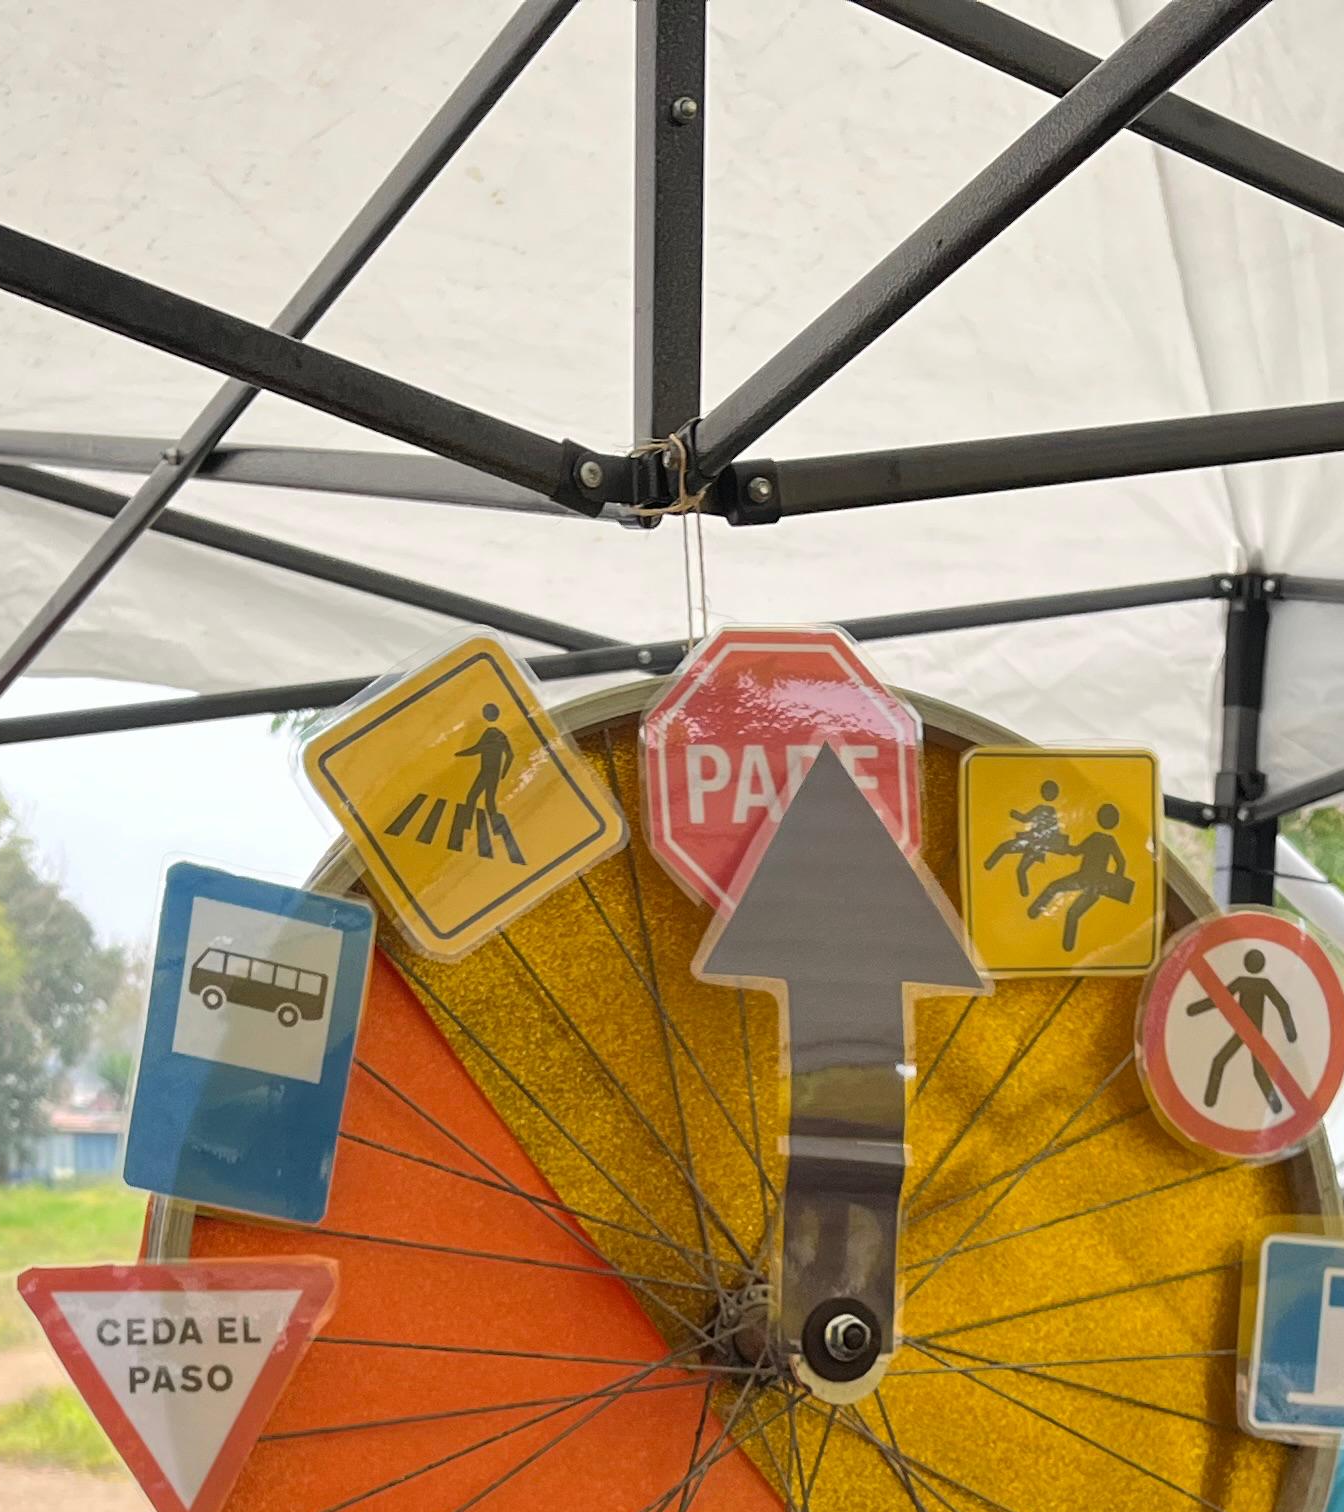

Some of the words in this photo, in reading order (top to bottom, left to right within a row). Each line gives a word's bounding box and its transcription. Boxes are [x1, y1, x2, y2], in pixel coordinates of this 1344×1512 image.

[96, 1317, 203, 1347] CEDA
[218, 1316, 262, 1345] EL
[129, 1365, 234, 1394] PASO
